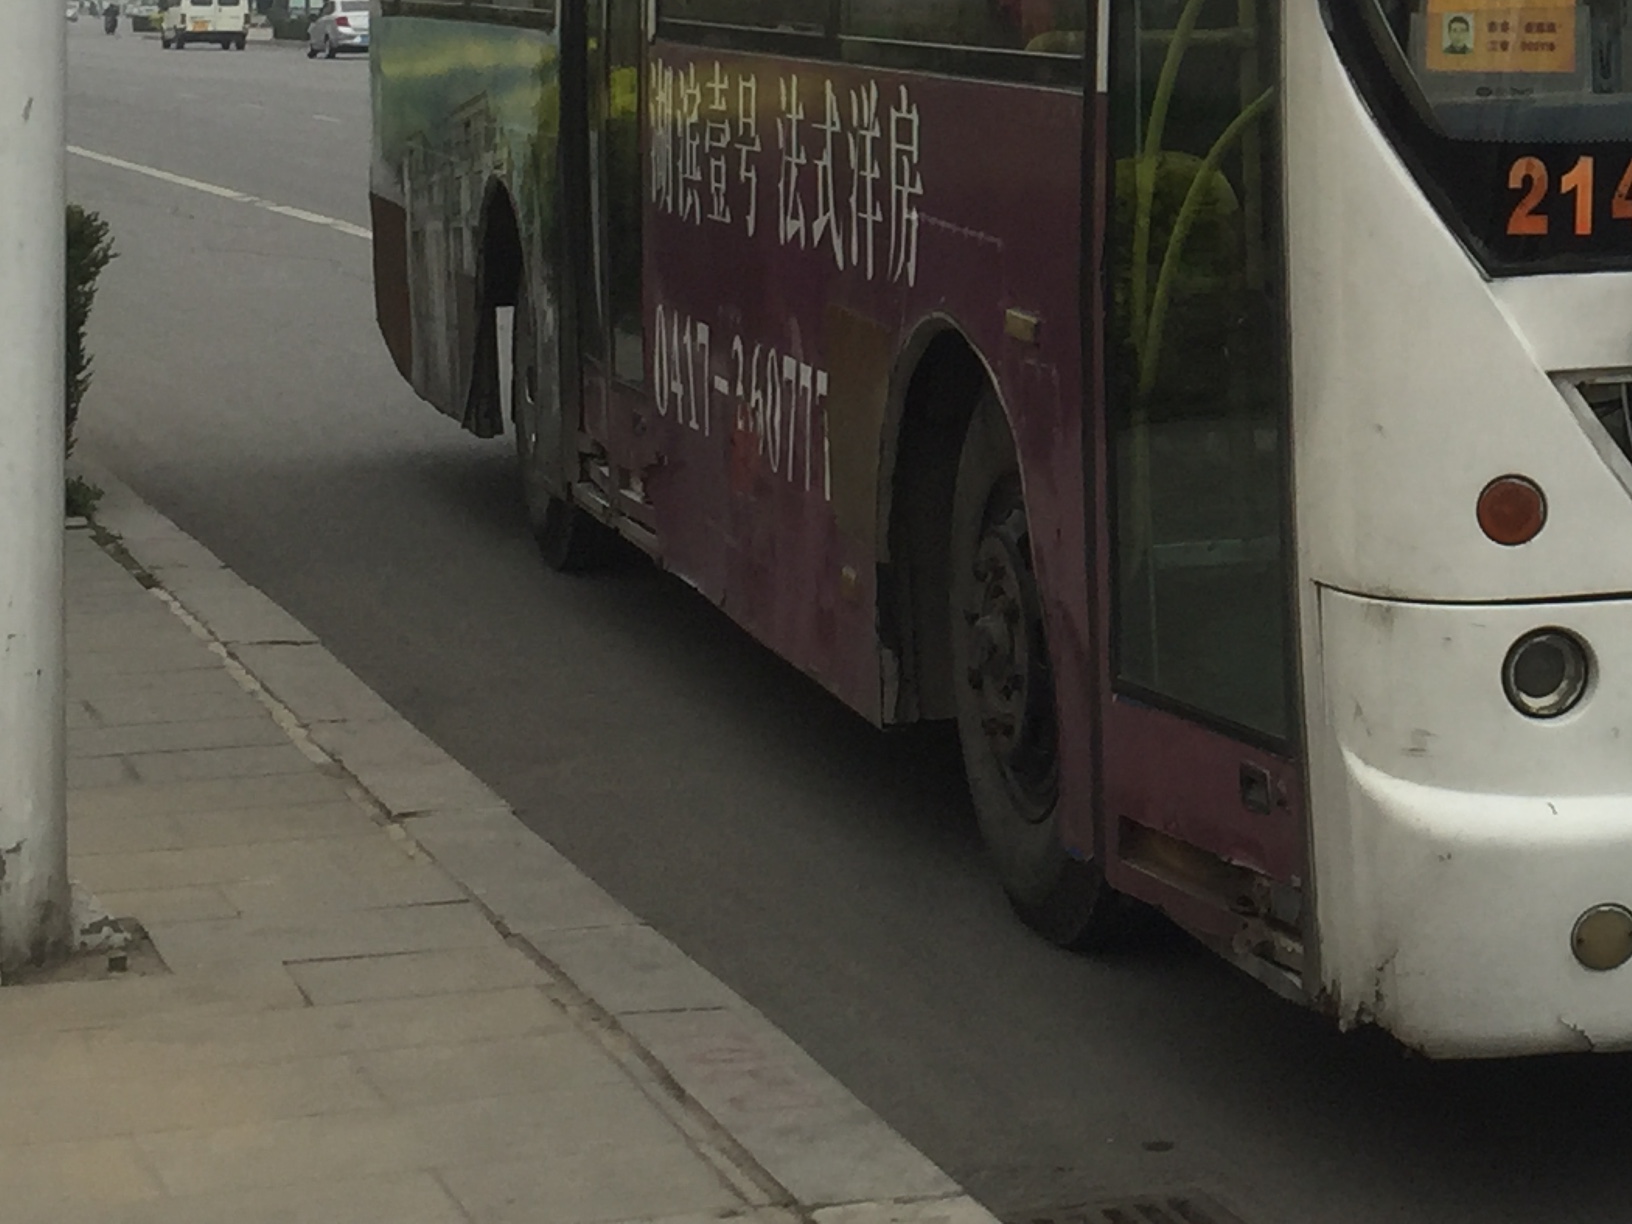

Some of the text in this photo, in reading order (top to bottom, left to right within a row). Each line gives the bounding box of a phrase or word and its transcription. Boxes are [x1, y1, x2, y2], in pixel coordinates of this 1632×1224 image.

[650, 57, 924, 288] 湖滨壹号 法式洋房
